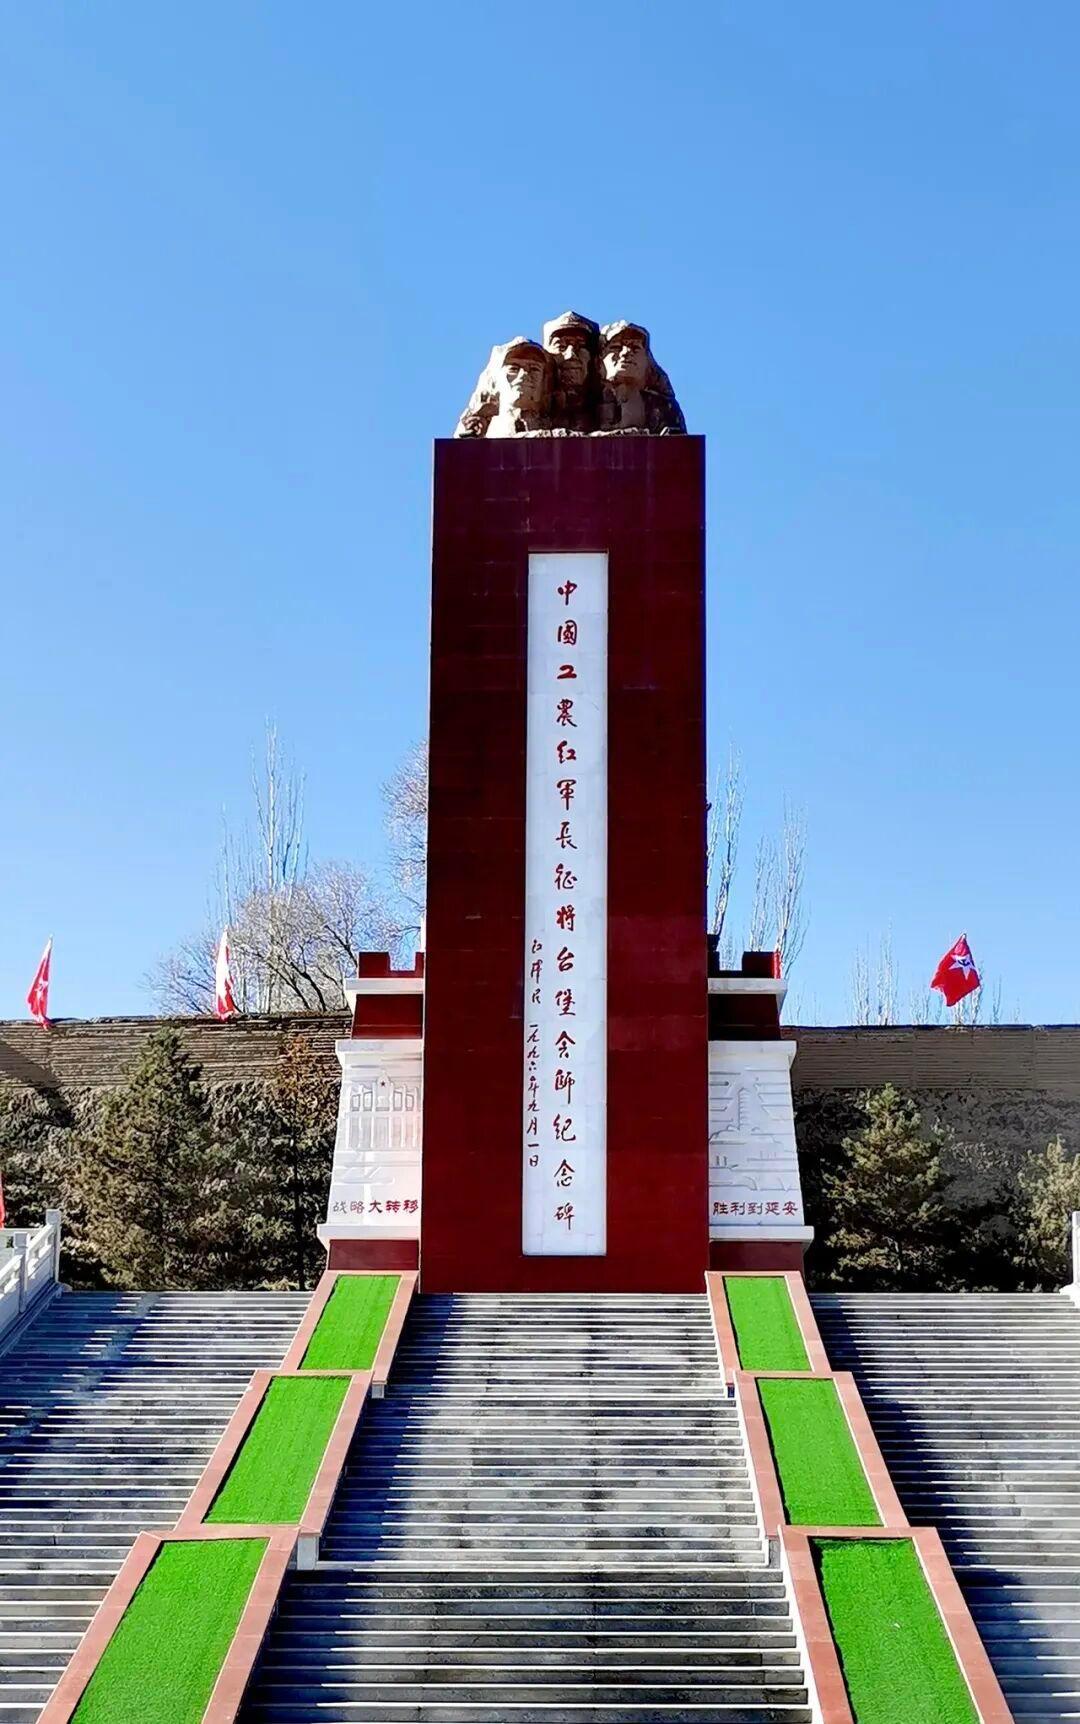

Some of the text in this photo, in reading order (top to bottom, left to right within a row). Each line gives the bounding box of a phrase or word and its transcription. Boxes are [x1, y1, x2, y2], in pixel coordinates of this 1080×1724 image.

[332, 1199, 419, 1214] 战略大转移
[712, 1200, 798, 1216] 胜利到延安
